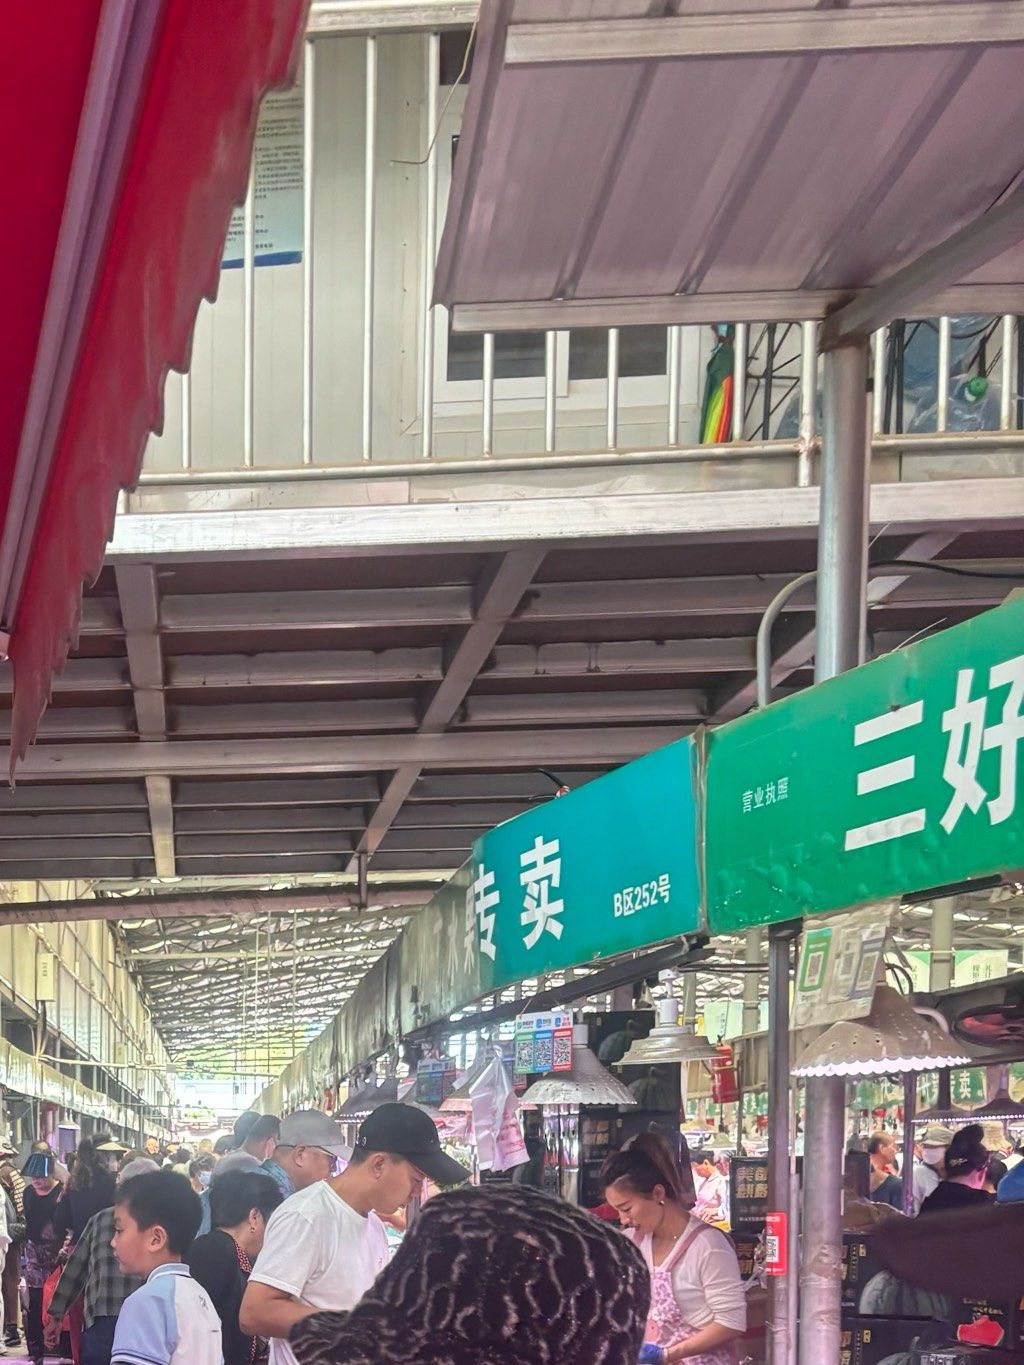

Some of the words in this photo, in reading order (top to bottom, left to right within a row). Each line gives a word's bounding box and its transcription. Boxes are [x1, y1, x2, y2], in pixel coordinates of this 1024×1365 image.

[742, 776, 789, 815] 营业执照
[613, 874, 671, 918] B区252号
